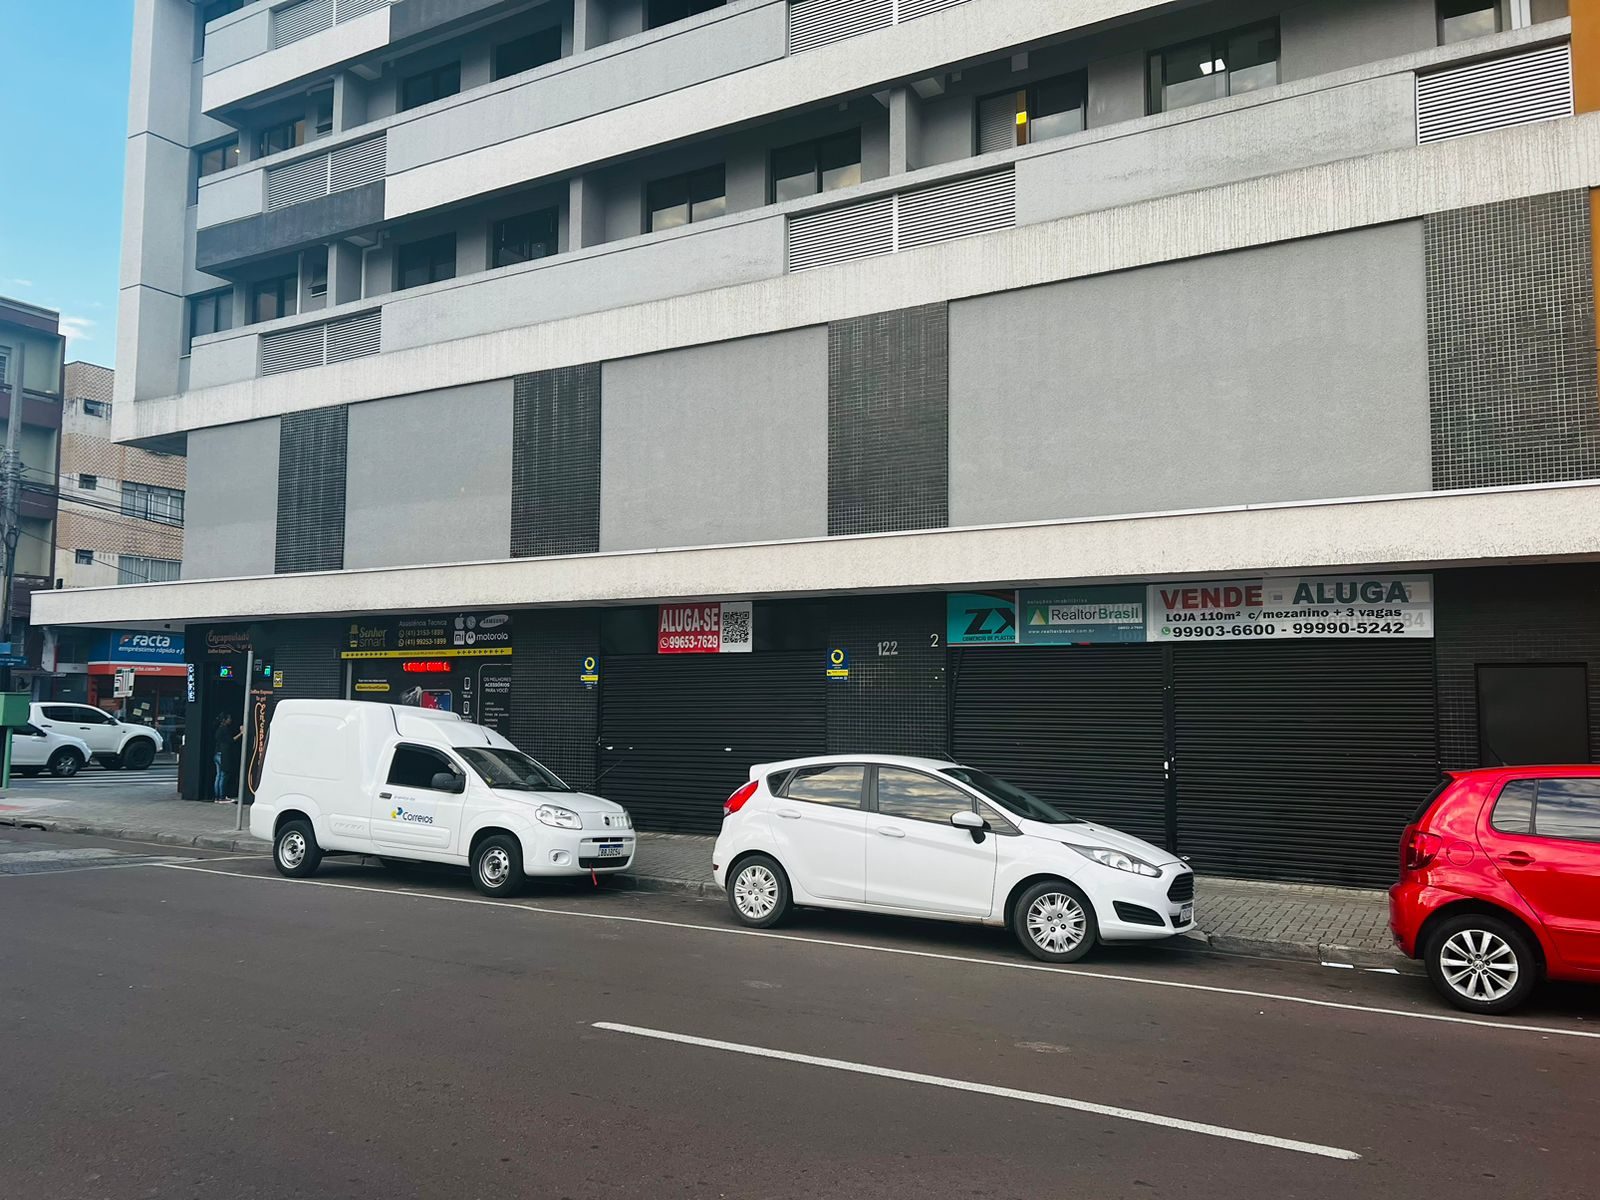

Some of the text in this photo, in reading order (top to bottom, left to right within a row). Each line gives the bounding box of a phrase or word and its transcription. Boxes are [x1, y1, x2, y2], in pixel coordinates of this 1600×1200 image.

[1160, 585, 1263, 609] VENDE
[1293, 581, 1409, 604] ALUGA
[660, 607, 719, 632] ALUGA-SE
[1166, 612, 1196, 622] LOJA
[1200, 610, 1241, 621] 110m²
[1248, 608, 1329, 621] c/mezanino
[1346, 608, 1354, 617] 3
[1359, 608, 1402, 618] vagas
[359, 627, 388, 638] Senhor
[476, 631, 509, 641] motorola
[1173, 624, 1275, 637] 99903-6600
[1293, 622, 1405, 634] 99990-5242
[132, 634, 171, 647] facta
[669, 635, 718, 648] 99653-7629
[930, 633, 939, 647] 2
[877, 641, 899, 656] 122
[402, 811, 434, 824] Correios
